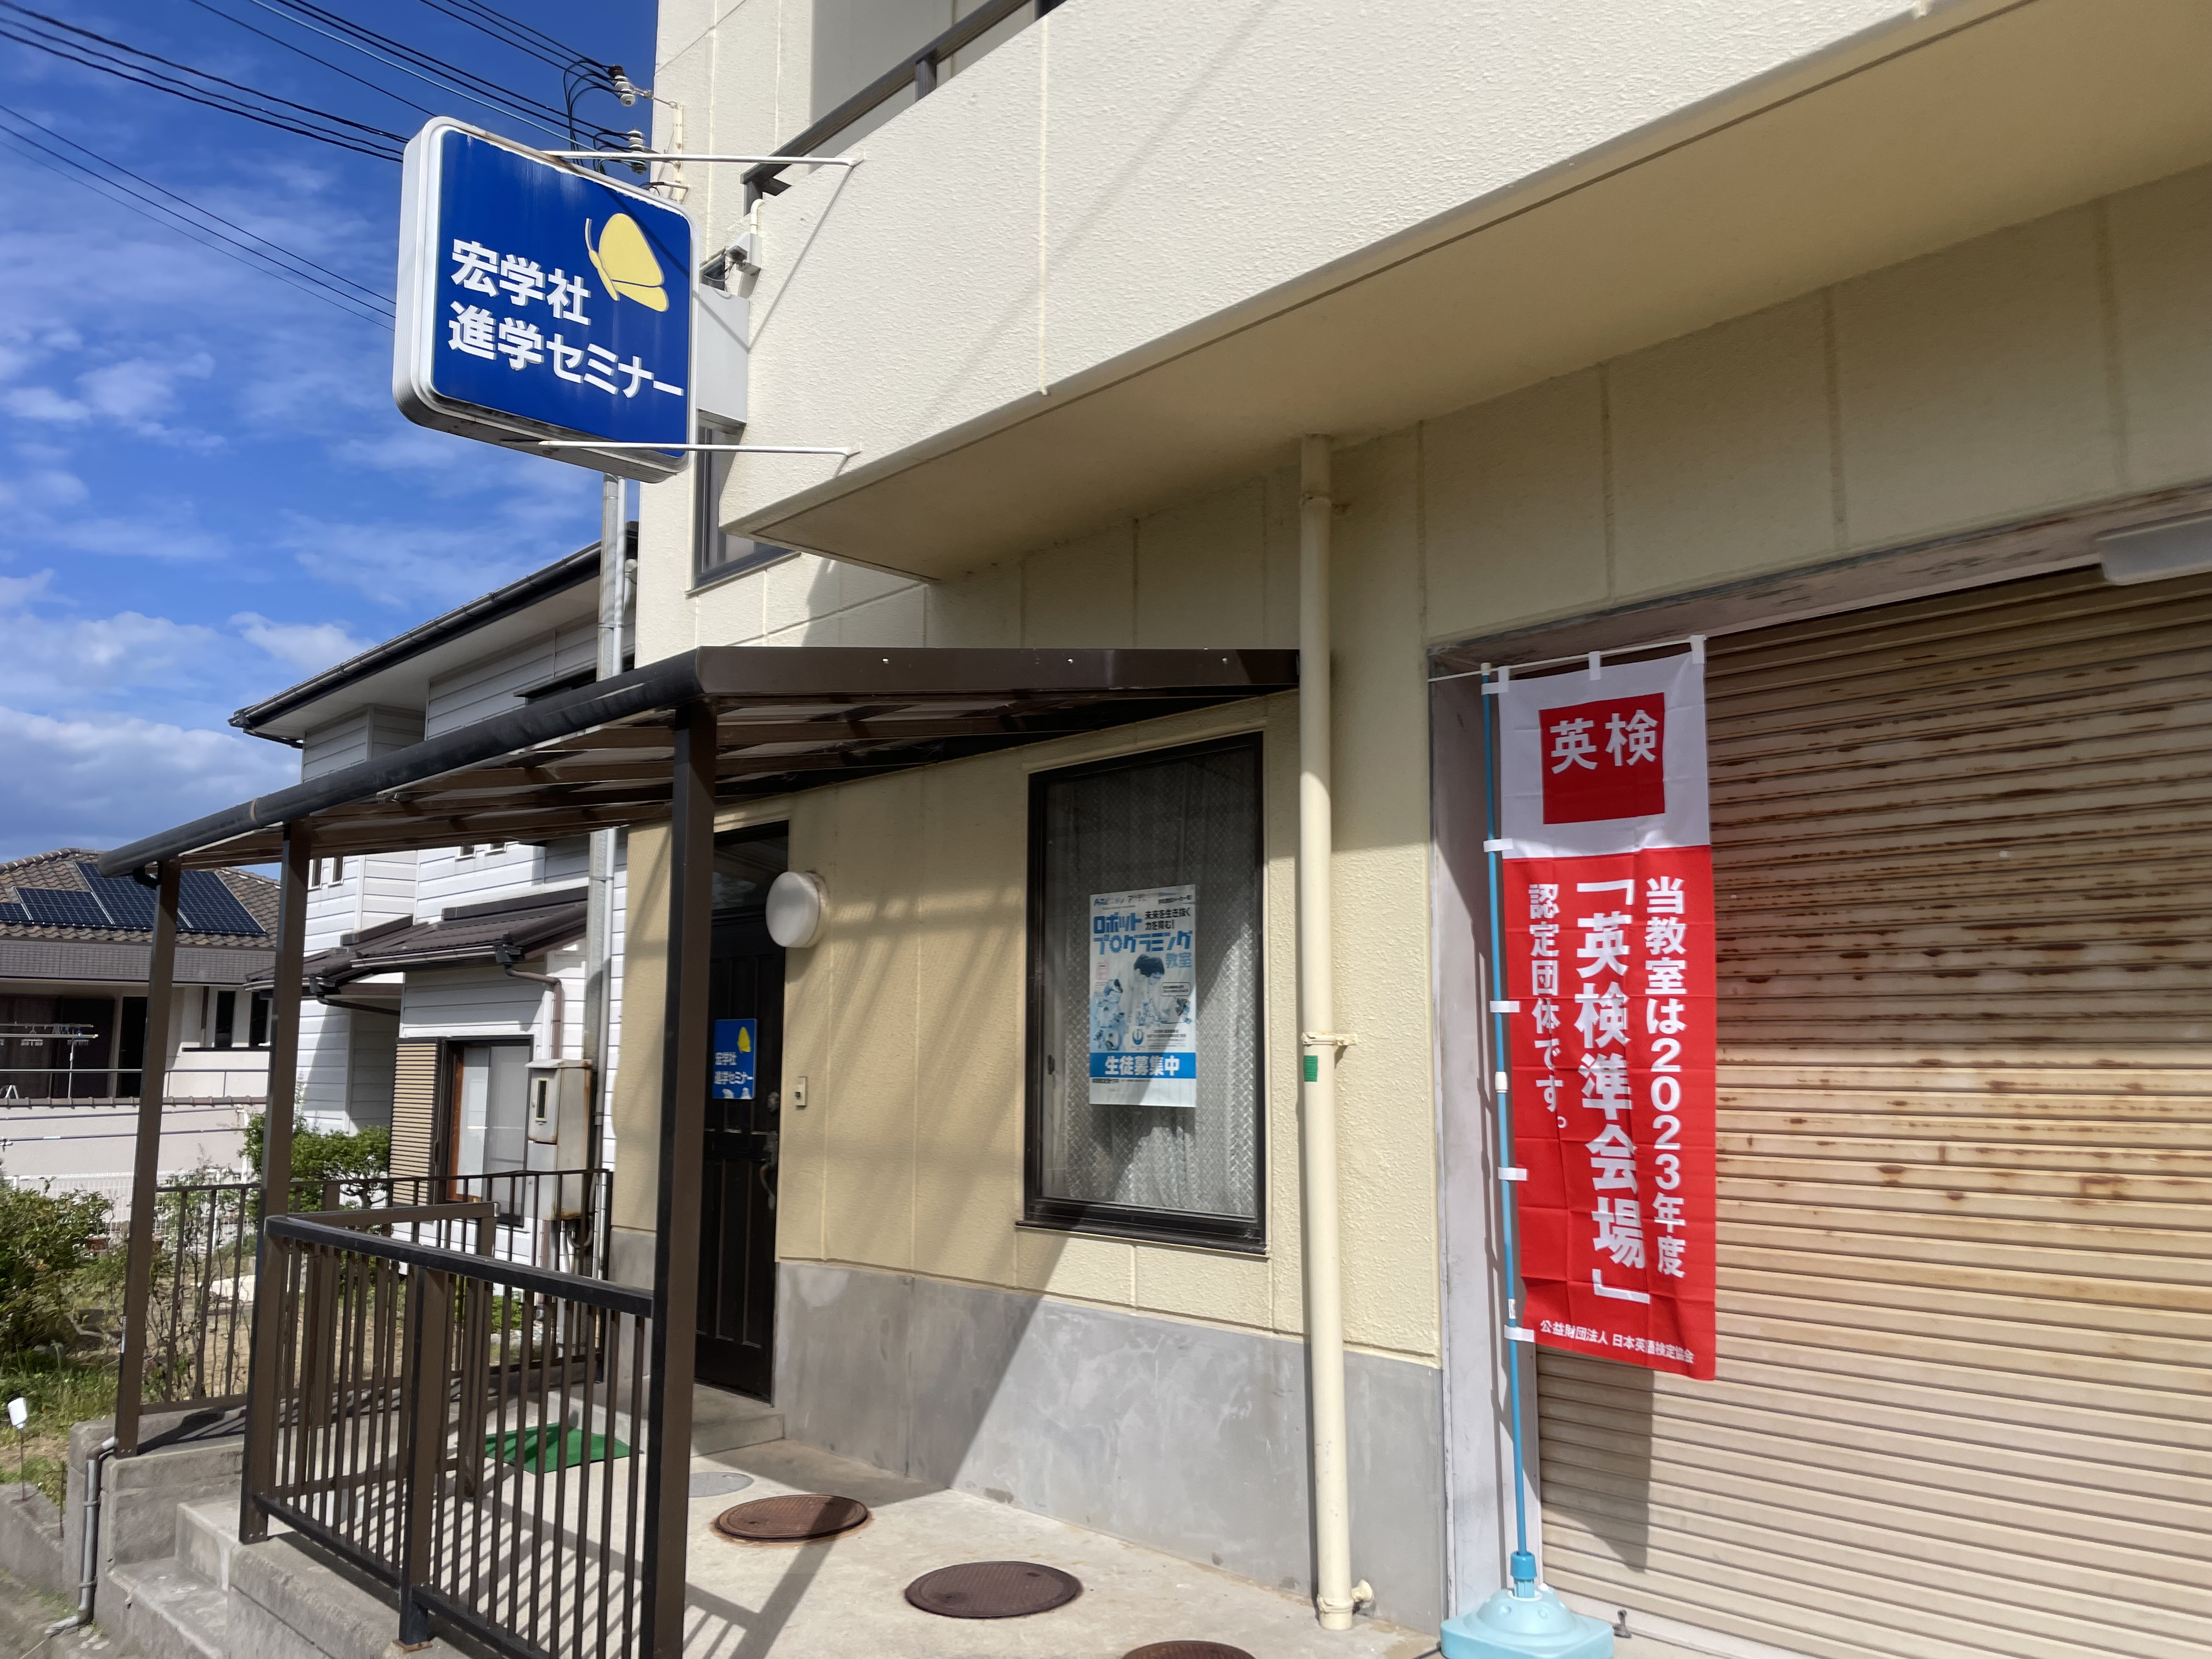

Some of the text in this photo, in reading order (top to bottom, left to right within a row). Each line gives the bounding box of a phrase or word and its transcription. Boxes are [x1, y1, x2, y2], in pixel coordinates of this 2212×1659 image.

[452, 239, 591, 325] 宏学社
[448, 301, 684, 398] 進学セミナー
[1550, 709, 1658, 774] 英検
[1093, 912, 1142, 934] ロボット
[1093, 930, 1193, 955] プログラミング
[1166, 952, 1192, 968] 教室
[1528, 884, 1567, 1128] 認定団体です。
[1105, 1056, 1181, 1076] 生徒募集中
[1575, 879, 1650, 1304] 「英検準会場」
[1645, 876, 1687, 1278] 当教室は2023年度
[1540, 1319, 1608, 1345] 公益財団法人
